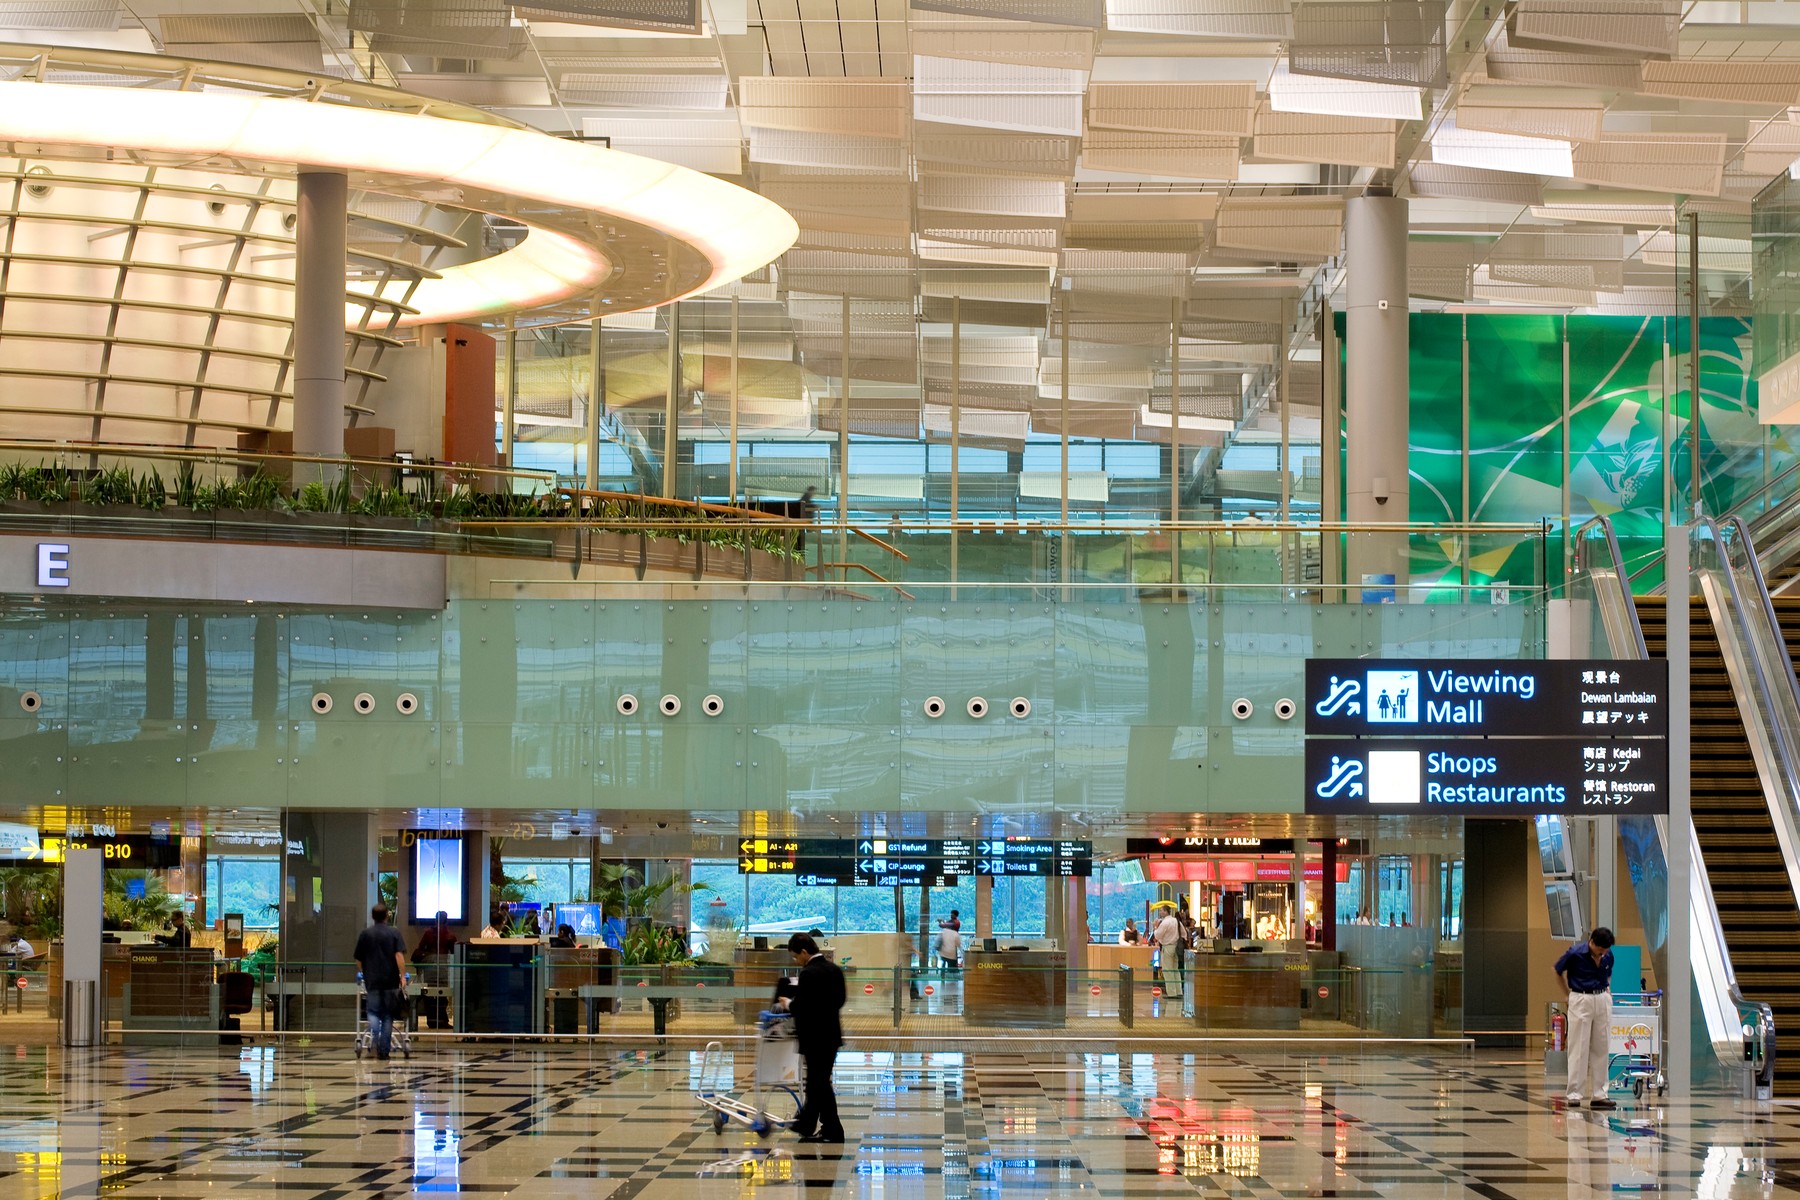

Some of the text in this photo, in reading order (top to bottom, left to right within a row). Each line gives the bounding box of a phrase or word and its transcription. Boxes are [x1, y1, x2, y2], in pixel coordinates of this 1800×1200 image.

[36, 543, 70, 587] E
[1427, 669, 1535, 699] Viewing
[1581, 670, 1621, 685] 观景台
[1581, 691, 1657, 704] Dewan Lambaian
[1426, 699, 1483, 724] Mall
[1581, 710, 1650, 725] 展望デッキ
[1583, 746, 1641, 760] 商店 Kedai
[1427, 751, 1497, 778] Shops
[1584, 760, 1631, 773] ショップ
[1427, 782, 1566, 804] Restaurants
[1610, 780, 1656, 793] Restoran
[1583, 794, 1633, 806] レストラン
[104, 844, 131, 858] B10
[901, 843, 927, 852] Refund
[1006, 845, 1035, 854] Smoking
[1006, 863, 1028, 871] Toilets
[823, 939, 829, 947] 5
